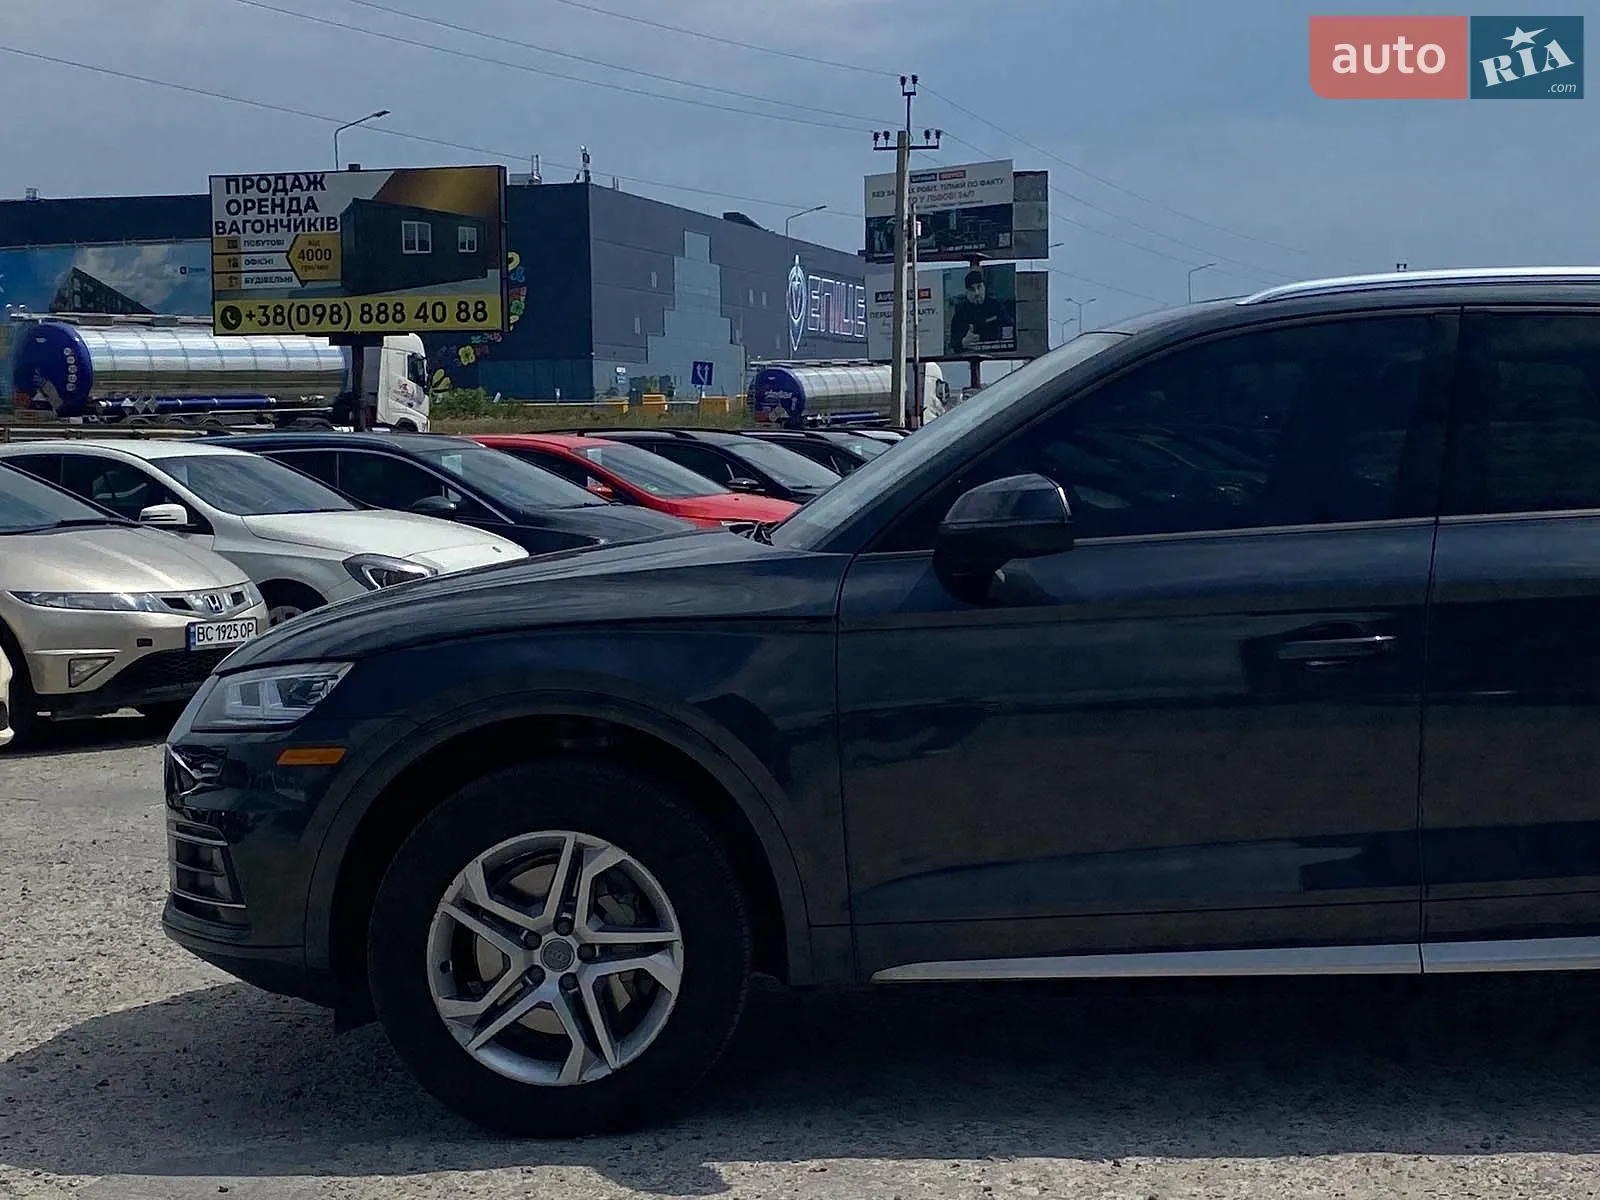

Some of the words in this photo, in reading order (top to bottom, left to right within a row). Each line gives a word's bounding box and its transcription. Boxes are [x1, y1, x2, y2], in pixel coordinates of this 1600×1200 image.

[225, 173, 326, 196] ПРОДАЖ
[225, 196, 319, 217] ОРЕНДА
[214, 216, 339, 236] ВАГОНЧИКІВ
[297, 248, 332, 262] 4000
[245, 301, 352, 331] +38(098)
[359, 302, 406, 325] 888
[414, 301, 447, 324] 40
[455, 300, 488, 323] 88
[197, 626, 213, 642] BC
[215, 623, 239, 641] 1925
